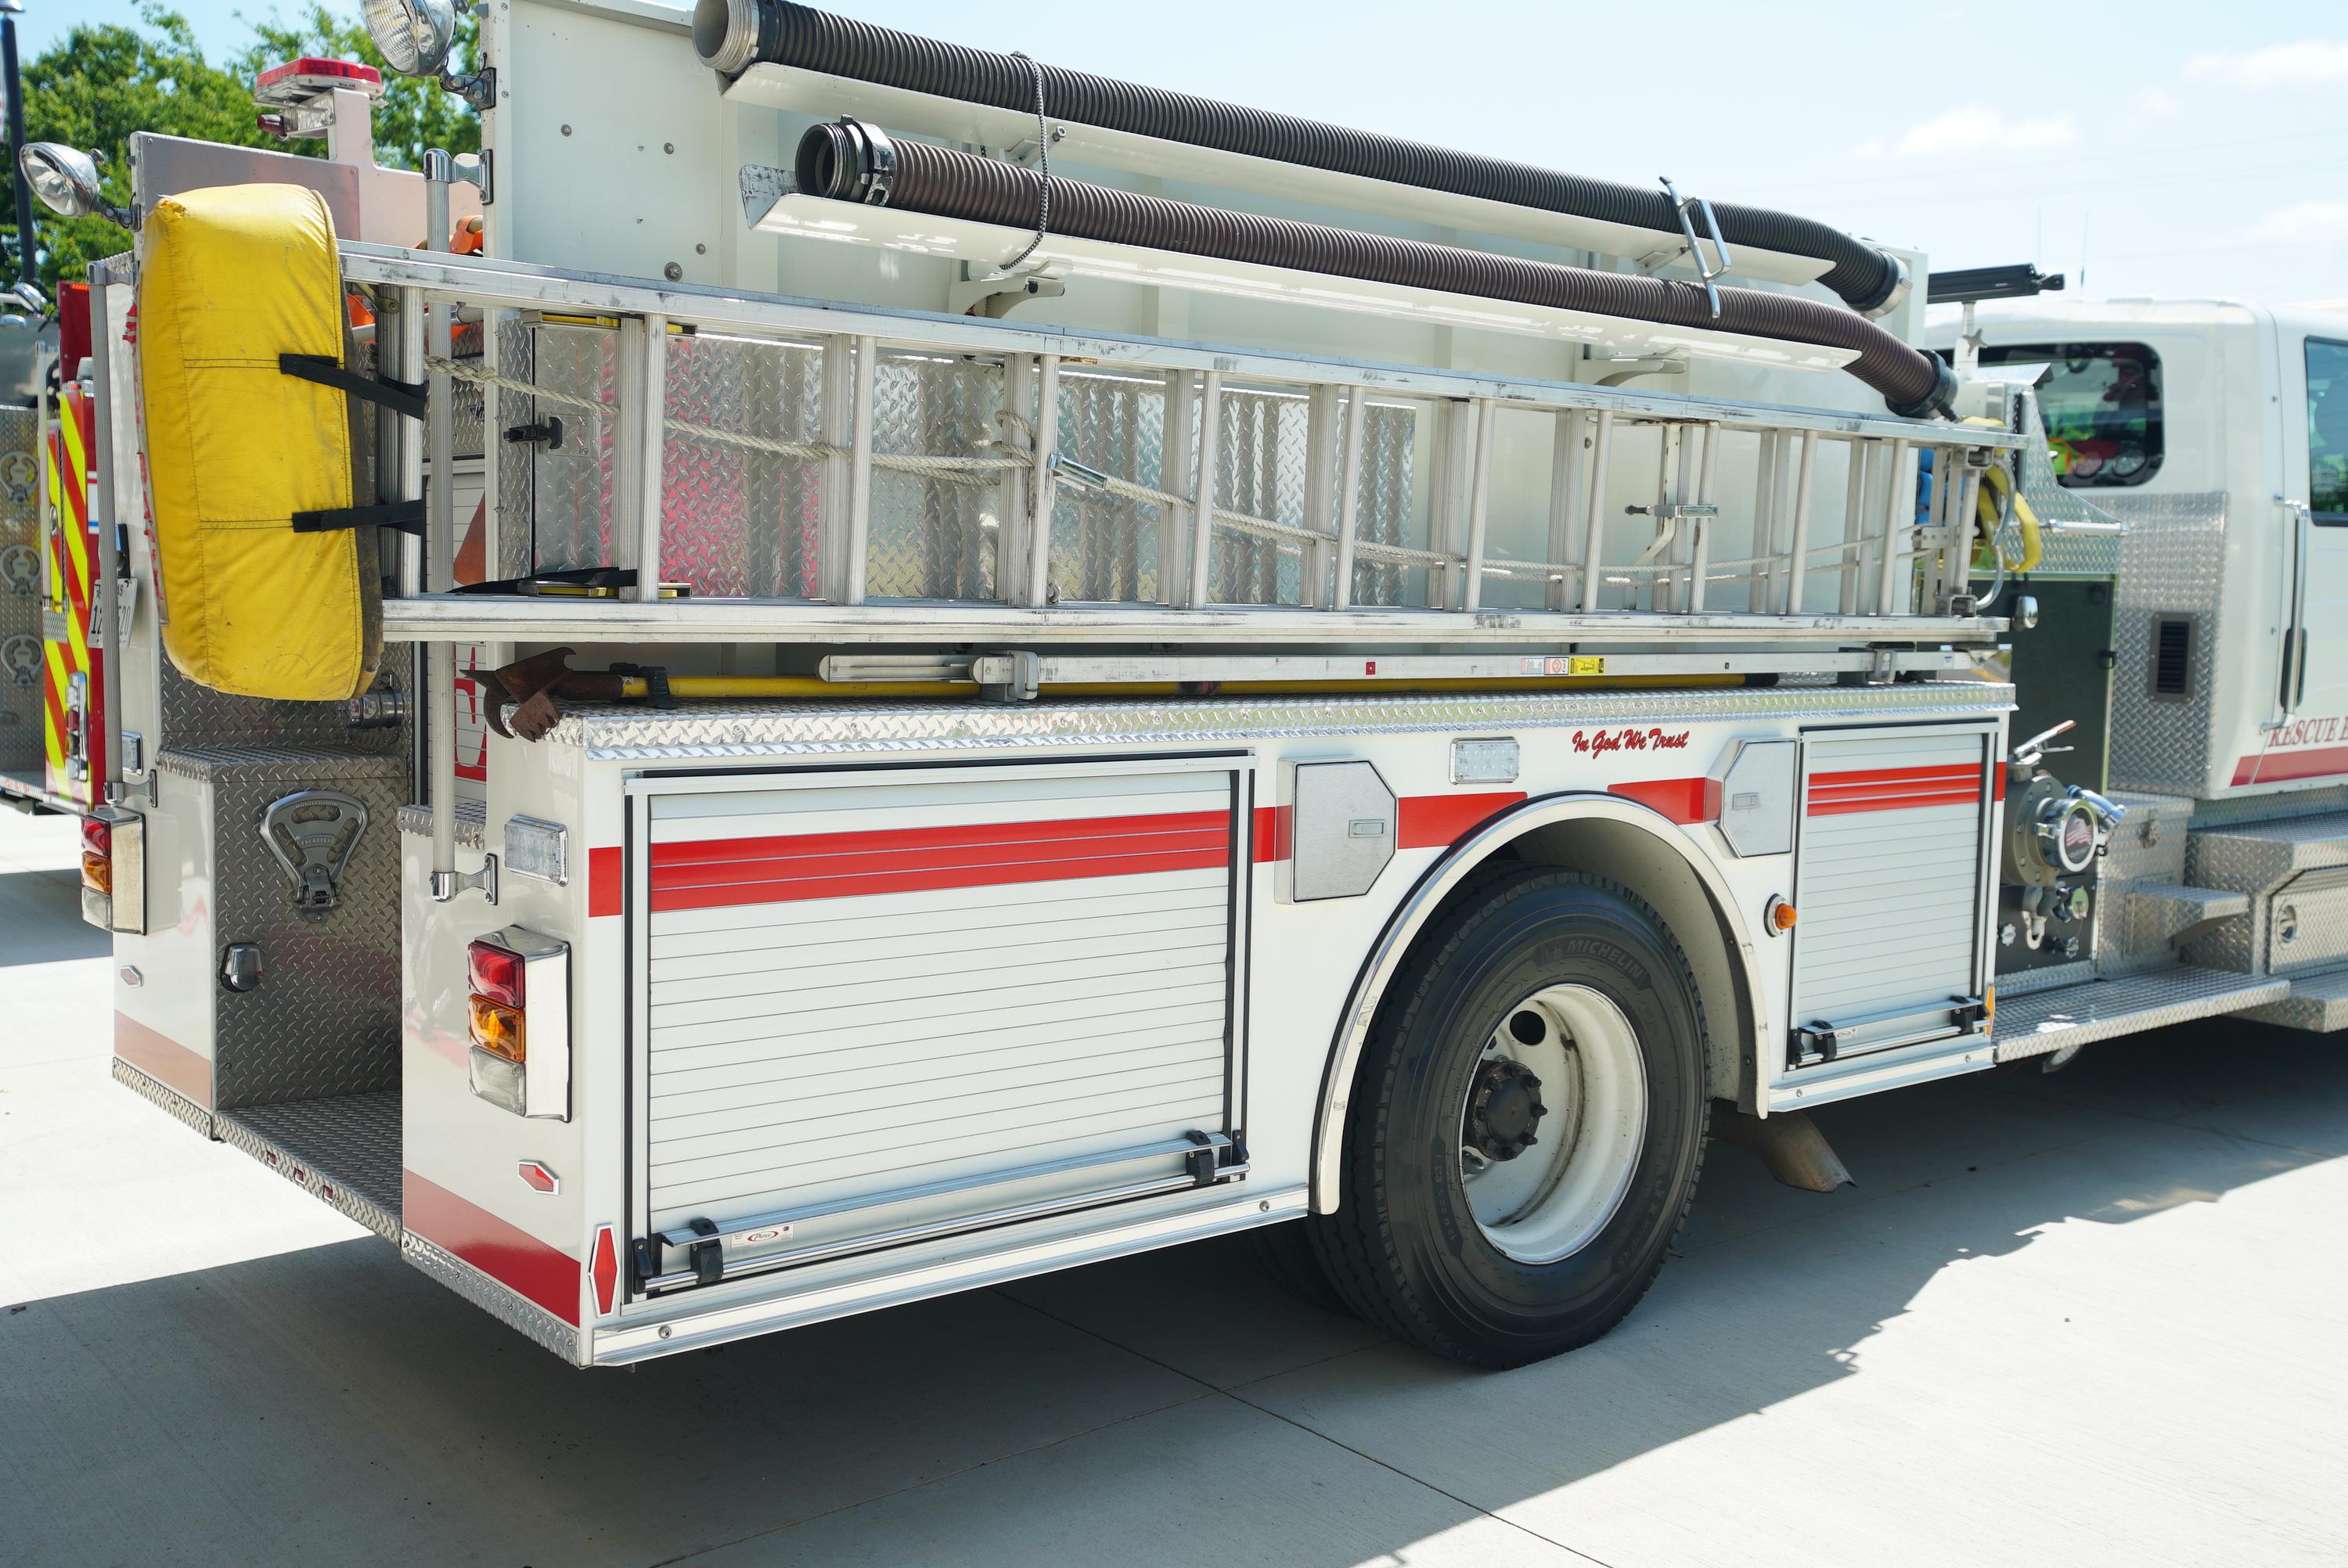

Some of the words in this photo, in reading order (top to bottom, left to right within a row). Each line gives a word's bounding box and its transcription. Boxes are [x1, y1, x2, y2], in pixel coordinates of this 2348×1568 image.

[1572, 730, 1589, 753] In
[1592, 729, 1622, 759] God
[1623, 728, 1647, 751] We
[1648, 728, 1690, 751] Trust
[2268, 717, 2339, 746] RESCUE
[1567, 938, 1644, 978] MICHELIN
